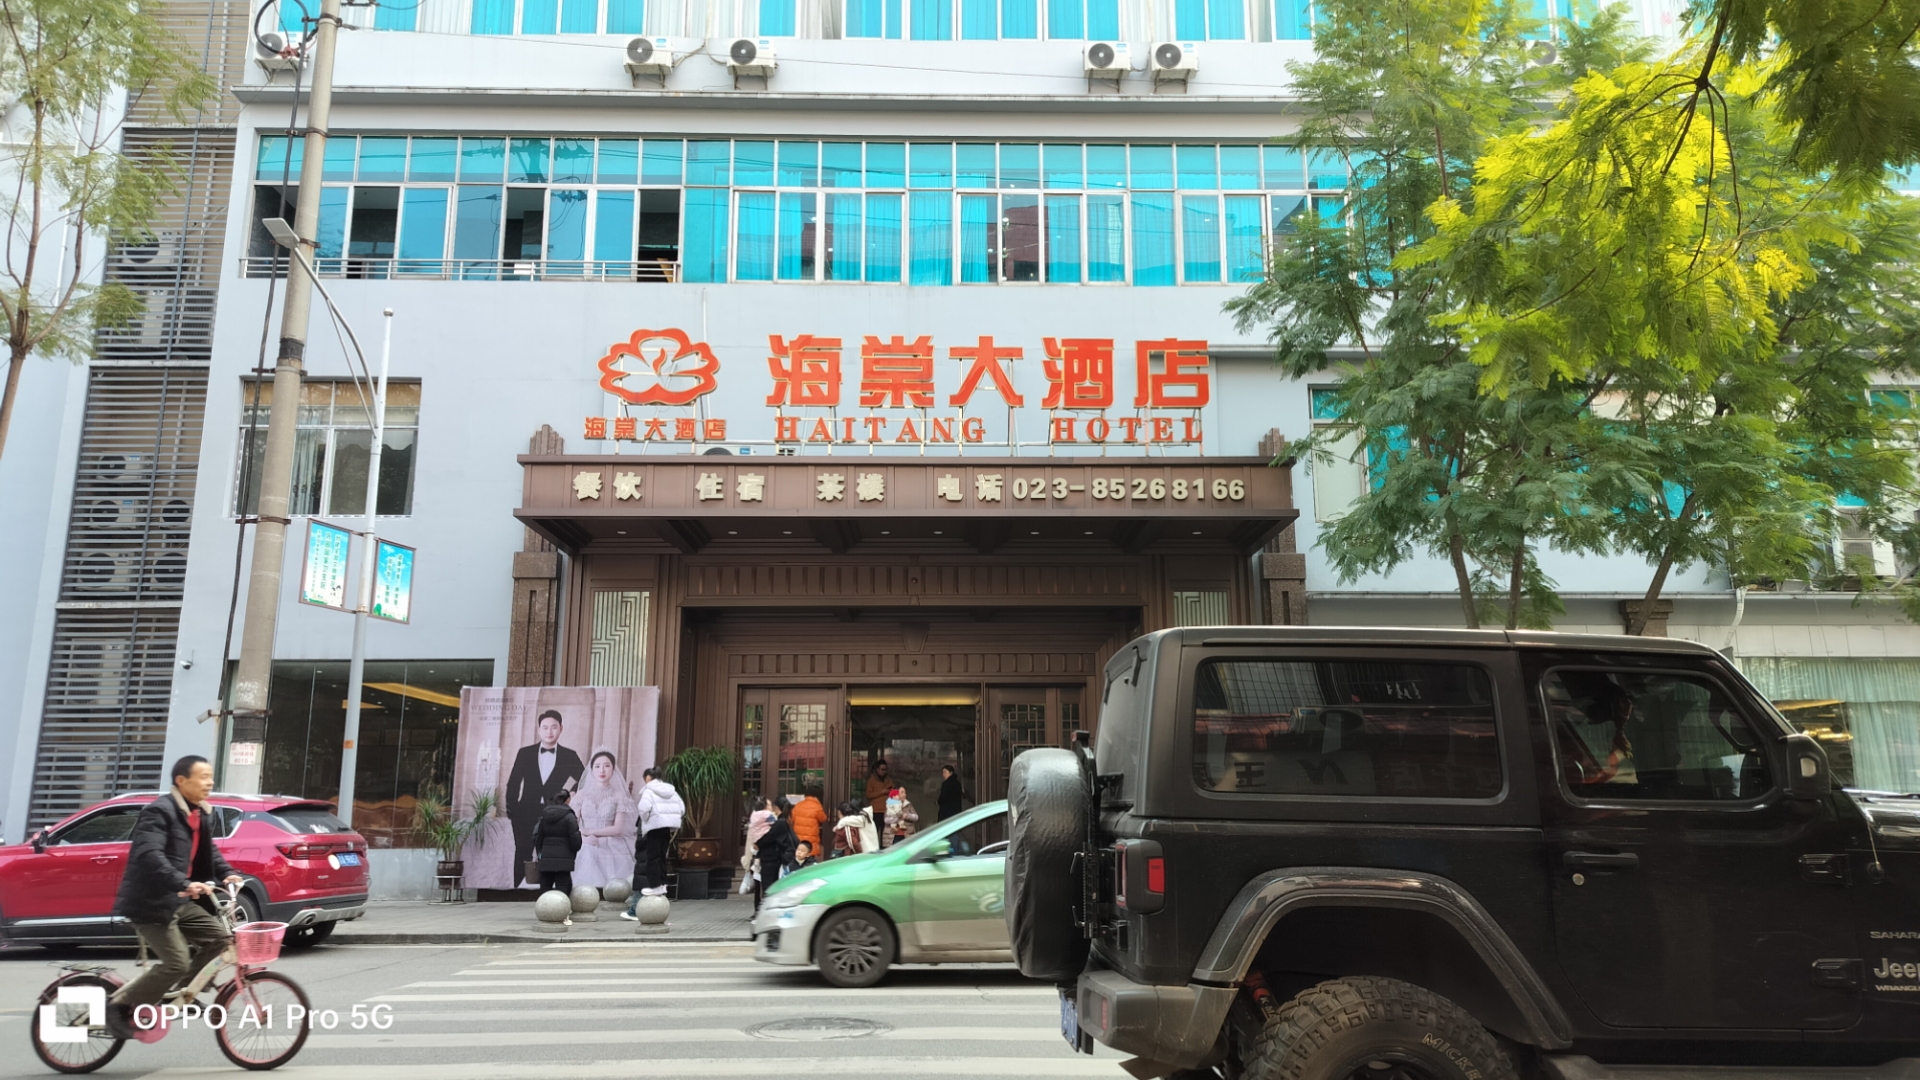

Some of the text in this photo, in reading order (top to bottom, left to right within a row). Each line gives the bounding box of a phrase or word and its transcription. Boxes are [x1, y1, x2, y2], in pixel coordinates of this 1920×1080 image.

[766, 333, 1210, 409] 海棠大酒店
[584, 416, 727, 440] 海棠大酒店
[774, 416, 1204, 443] HAITANG HOTEL
[572, 471, 643, 501] 餐饮
[695, 472, 765, 502] 住宿
[816, 472, 886, 502] 茶楼
[1870, 931, 1920, 939] SAHAR
[1875, 984, 1920, 992] WRANGL
